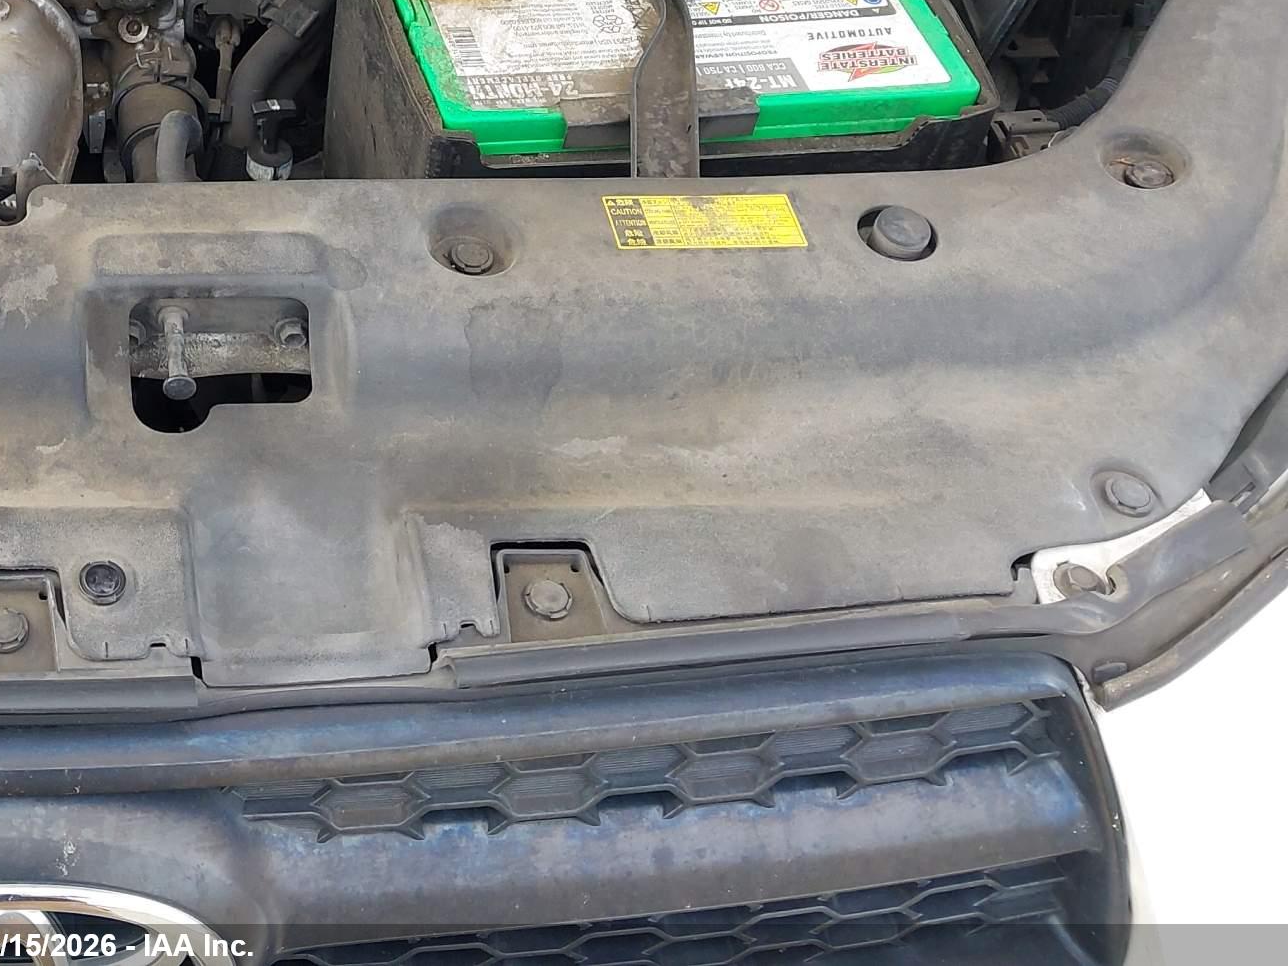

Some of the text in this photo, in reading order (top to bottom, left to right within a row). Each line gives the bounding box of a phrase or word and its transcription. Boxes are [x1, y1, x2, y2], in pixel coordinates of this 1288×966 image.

[758, 9, 861, 23] DANGER/POISON
[806, 26, 893, 41] AUTOMOTIVE
[820, 47, 908, 61] BATTERIES
[818, 56, 917, 72] INTERSTATE
[468, 80, 579, 101] 24-MONTH
[609, 208, 644, 216] CAUTION
[614, 218, 648, 227] ATTENTION
